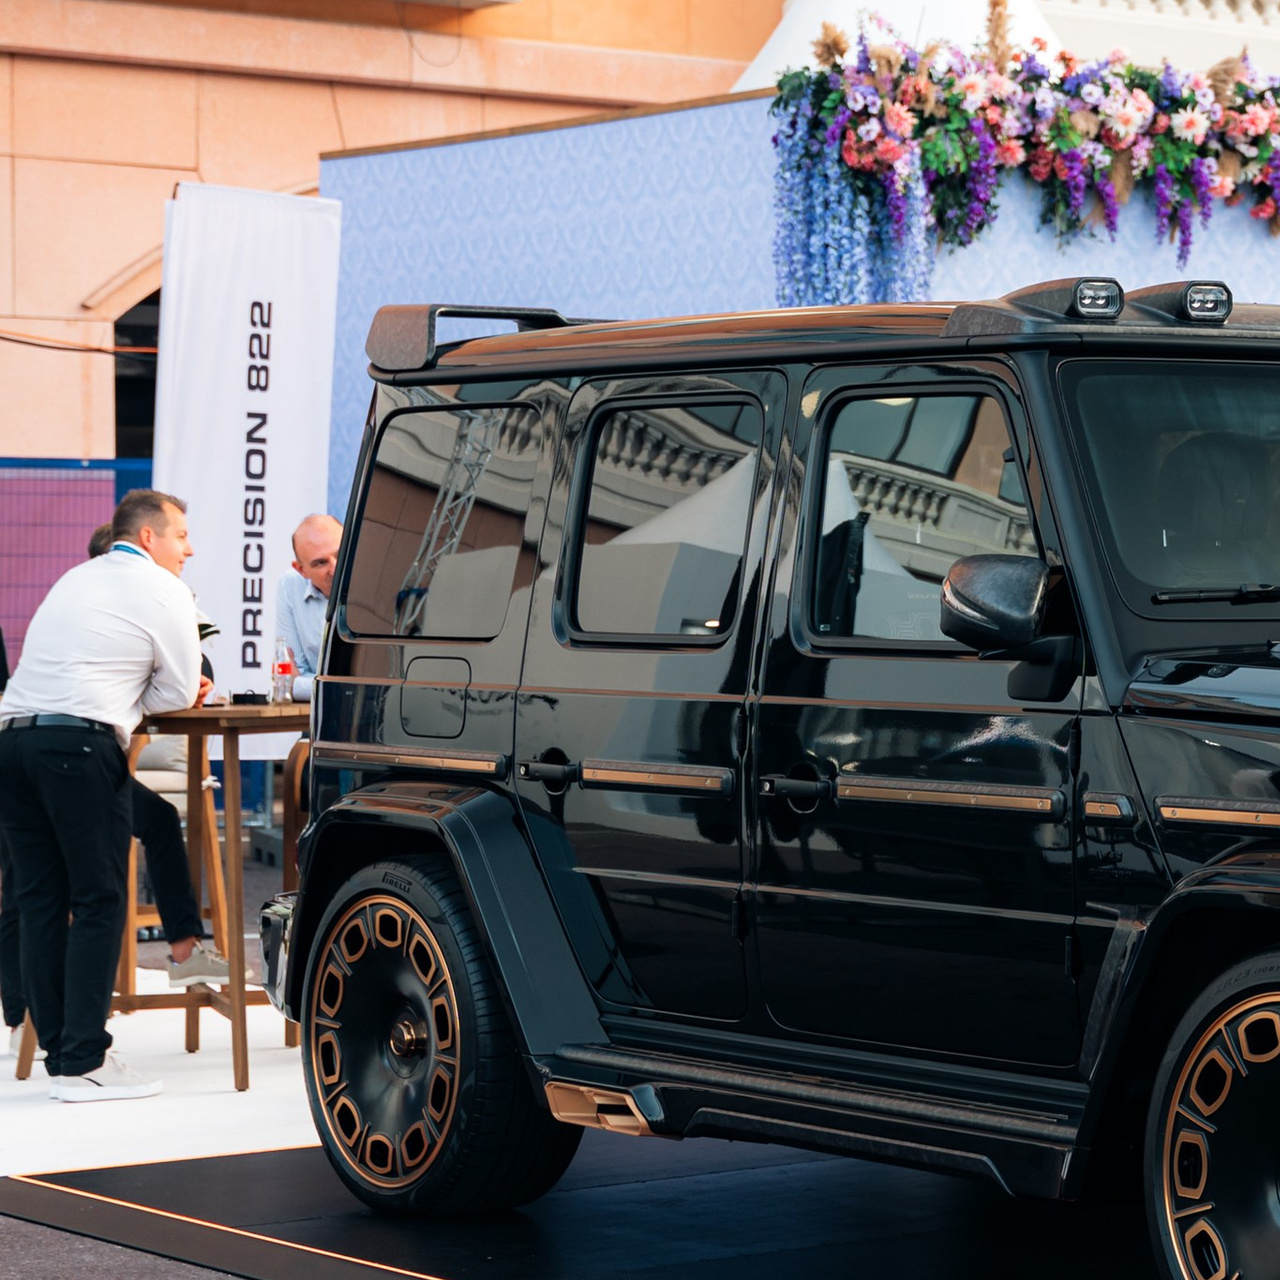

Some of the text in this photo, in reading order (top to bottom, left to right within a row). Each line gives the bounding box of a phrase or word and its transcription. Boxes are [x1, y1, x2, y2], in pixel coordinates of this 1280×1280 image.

[241, 301, 273, 669] PRECISION 822
[381, 870, 413, 894] PIRELLI
